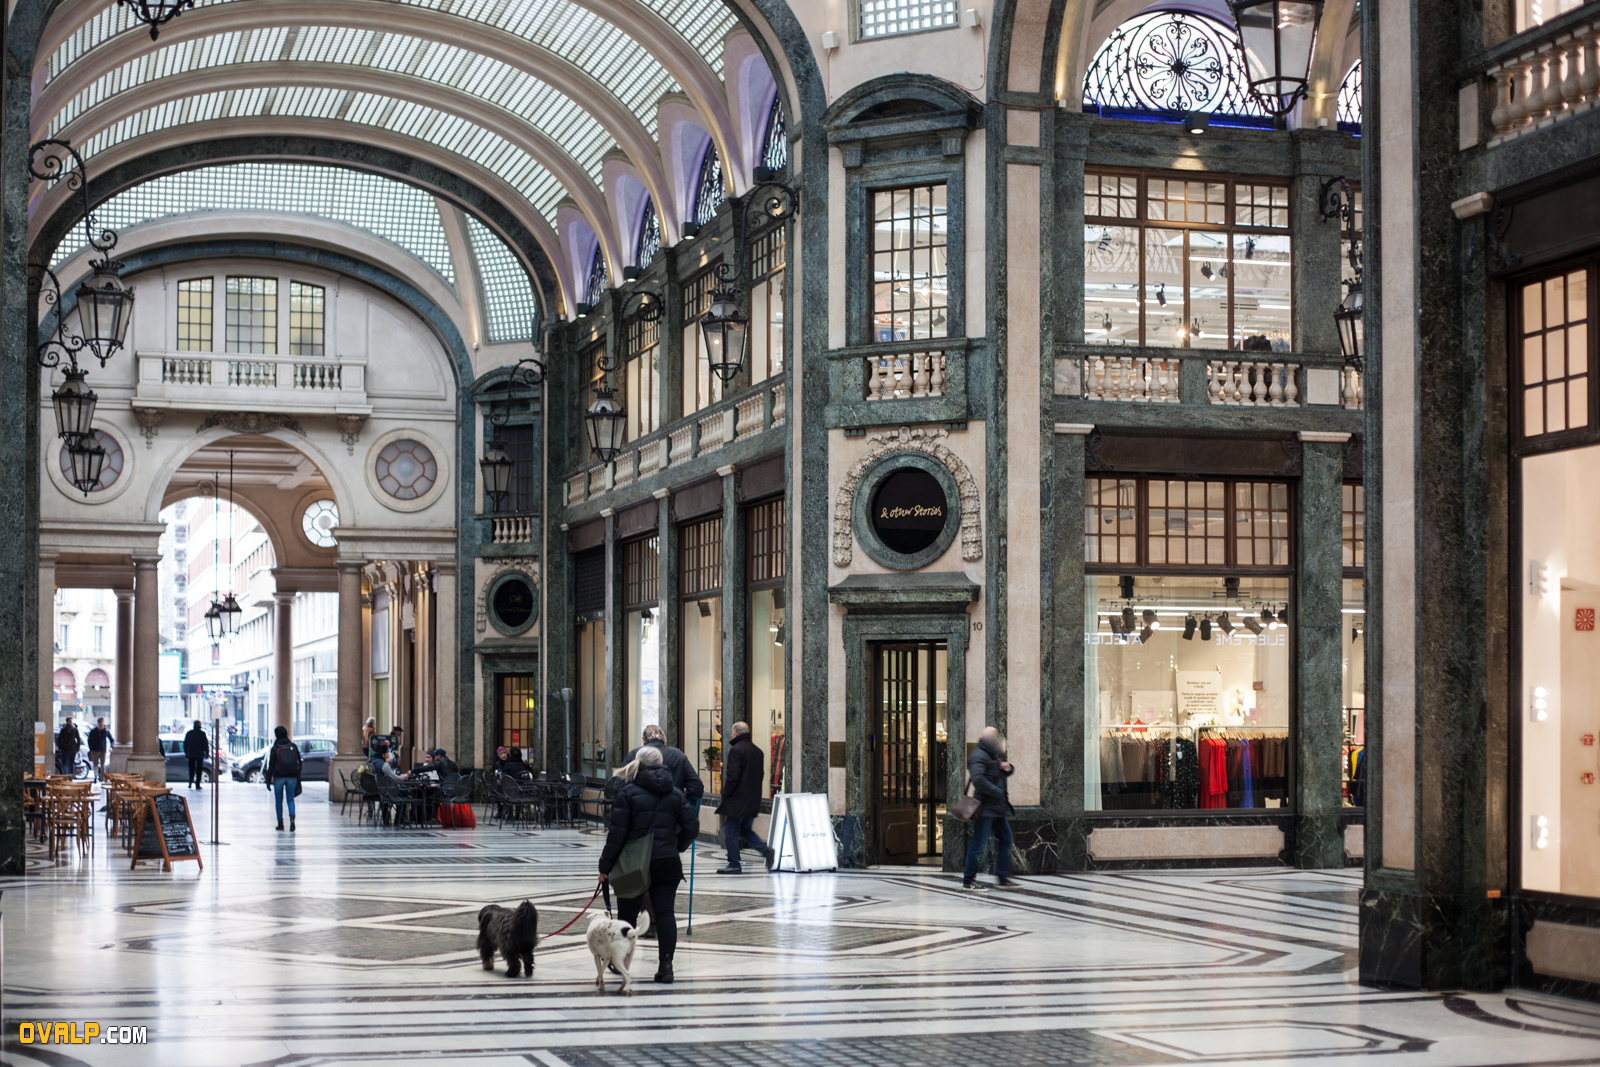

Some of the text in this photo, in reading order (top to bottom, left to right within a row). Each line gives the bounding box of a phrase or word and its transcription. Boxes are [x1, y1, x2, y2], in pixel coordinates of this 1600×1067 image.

[880, 504, 942, 519] & other Stories
[973, 621, 983, 631] 10
